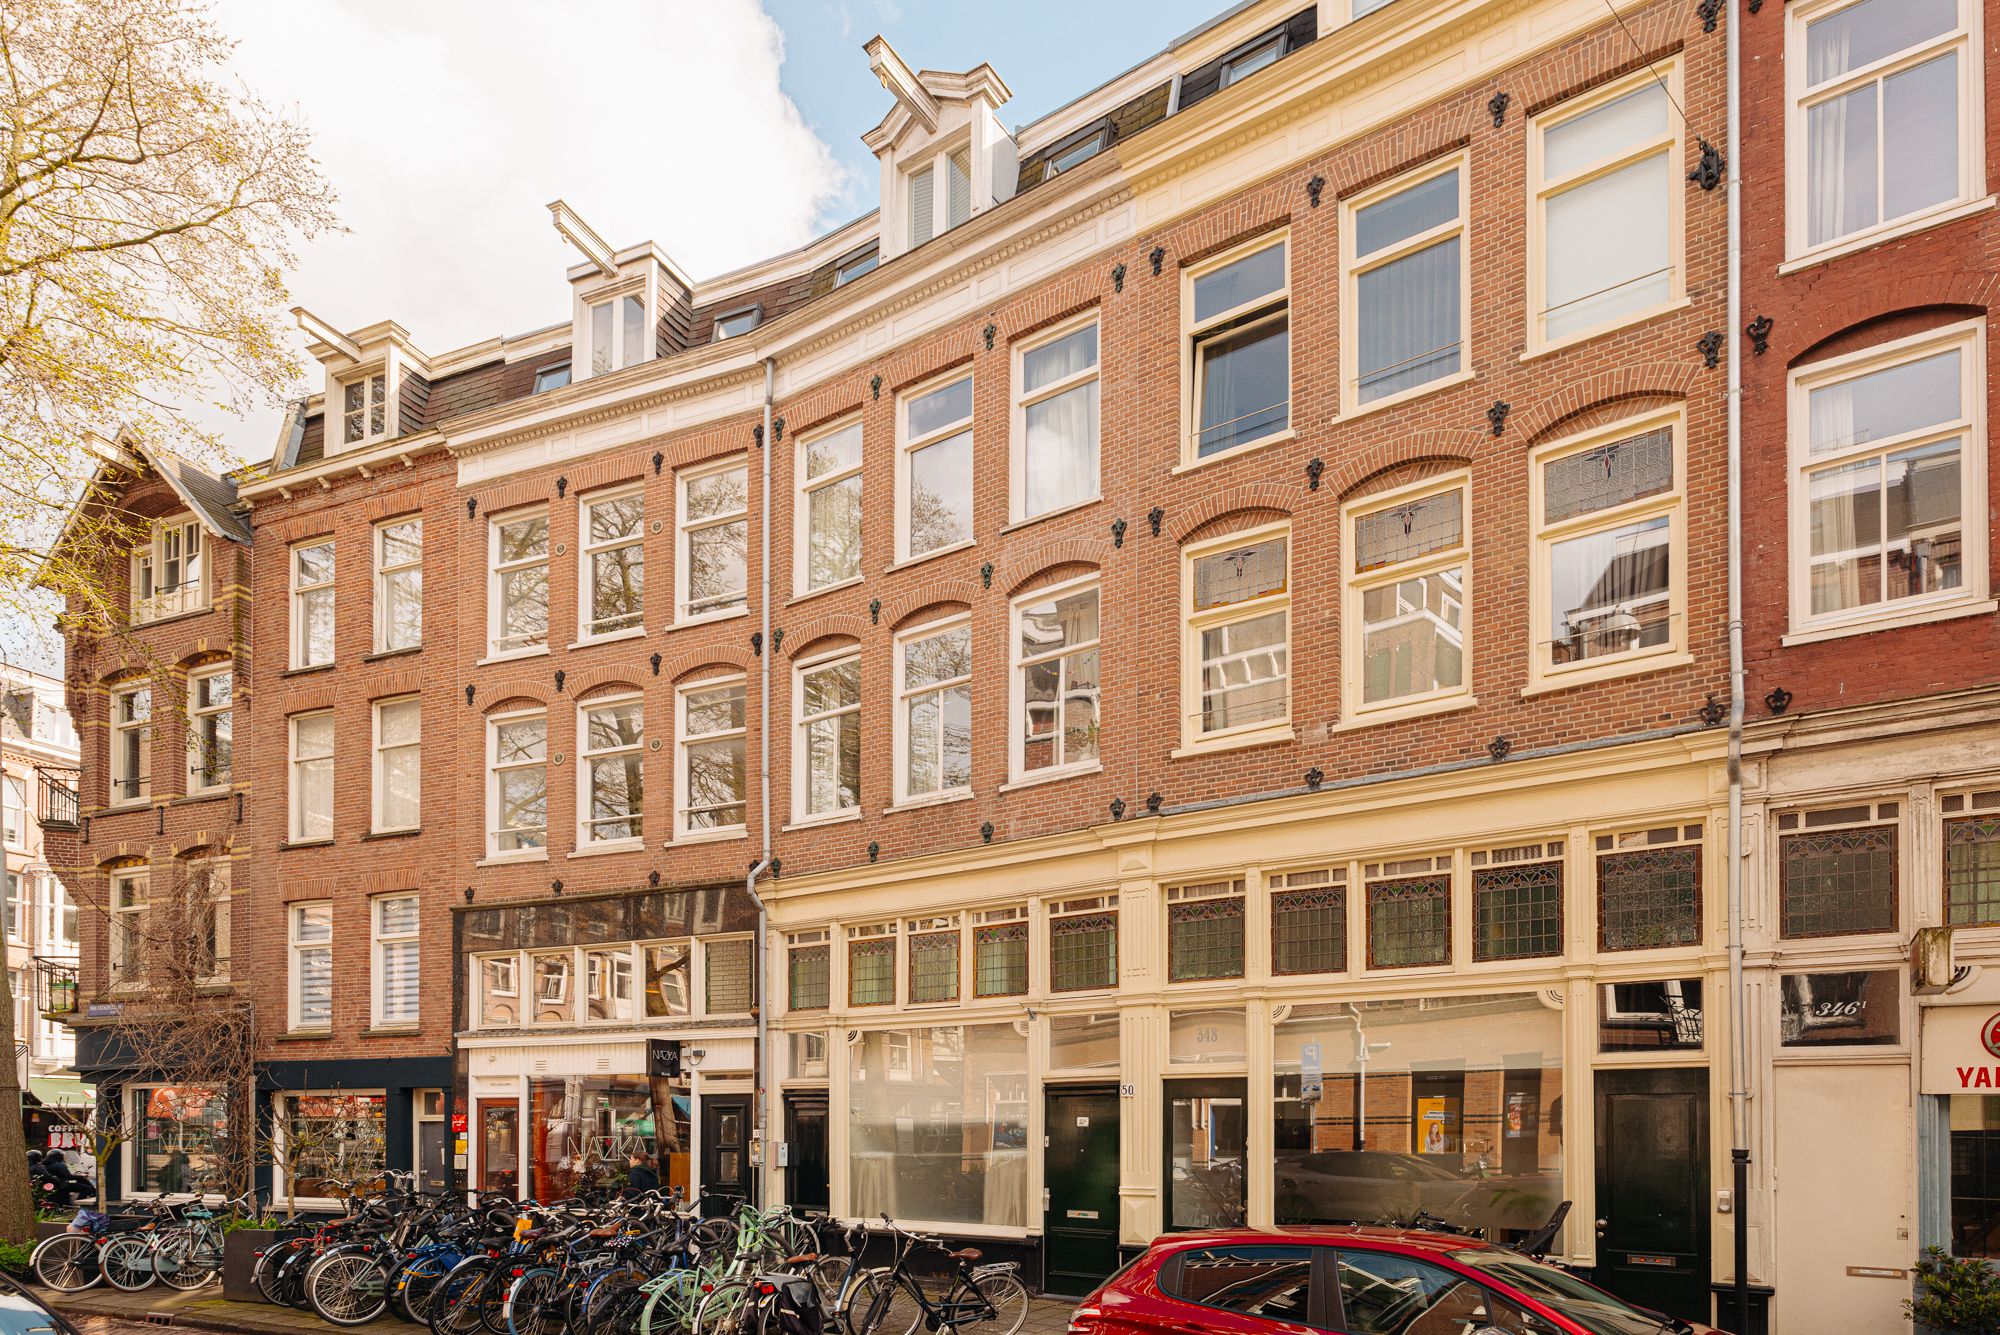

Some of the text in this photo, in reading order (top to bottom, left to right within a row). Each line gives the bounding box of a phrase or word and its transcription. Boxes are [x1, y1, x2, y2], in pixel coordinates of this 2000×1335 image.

[652, 1050, 678, 1060] NAZKA
[1956, 1066, 2000, 1088] YA
[1120, 1084, 1134, 1096] 50
[567, 1136, 648, 1161] NAZKA
